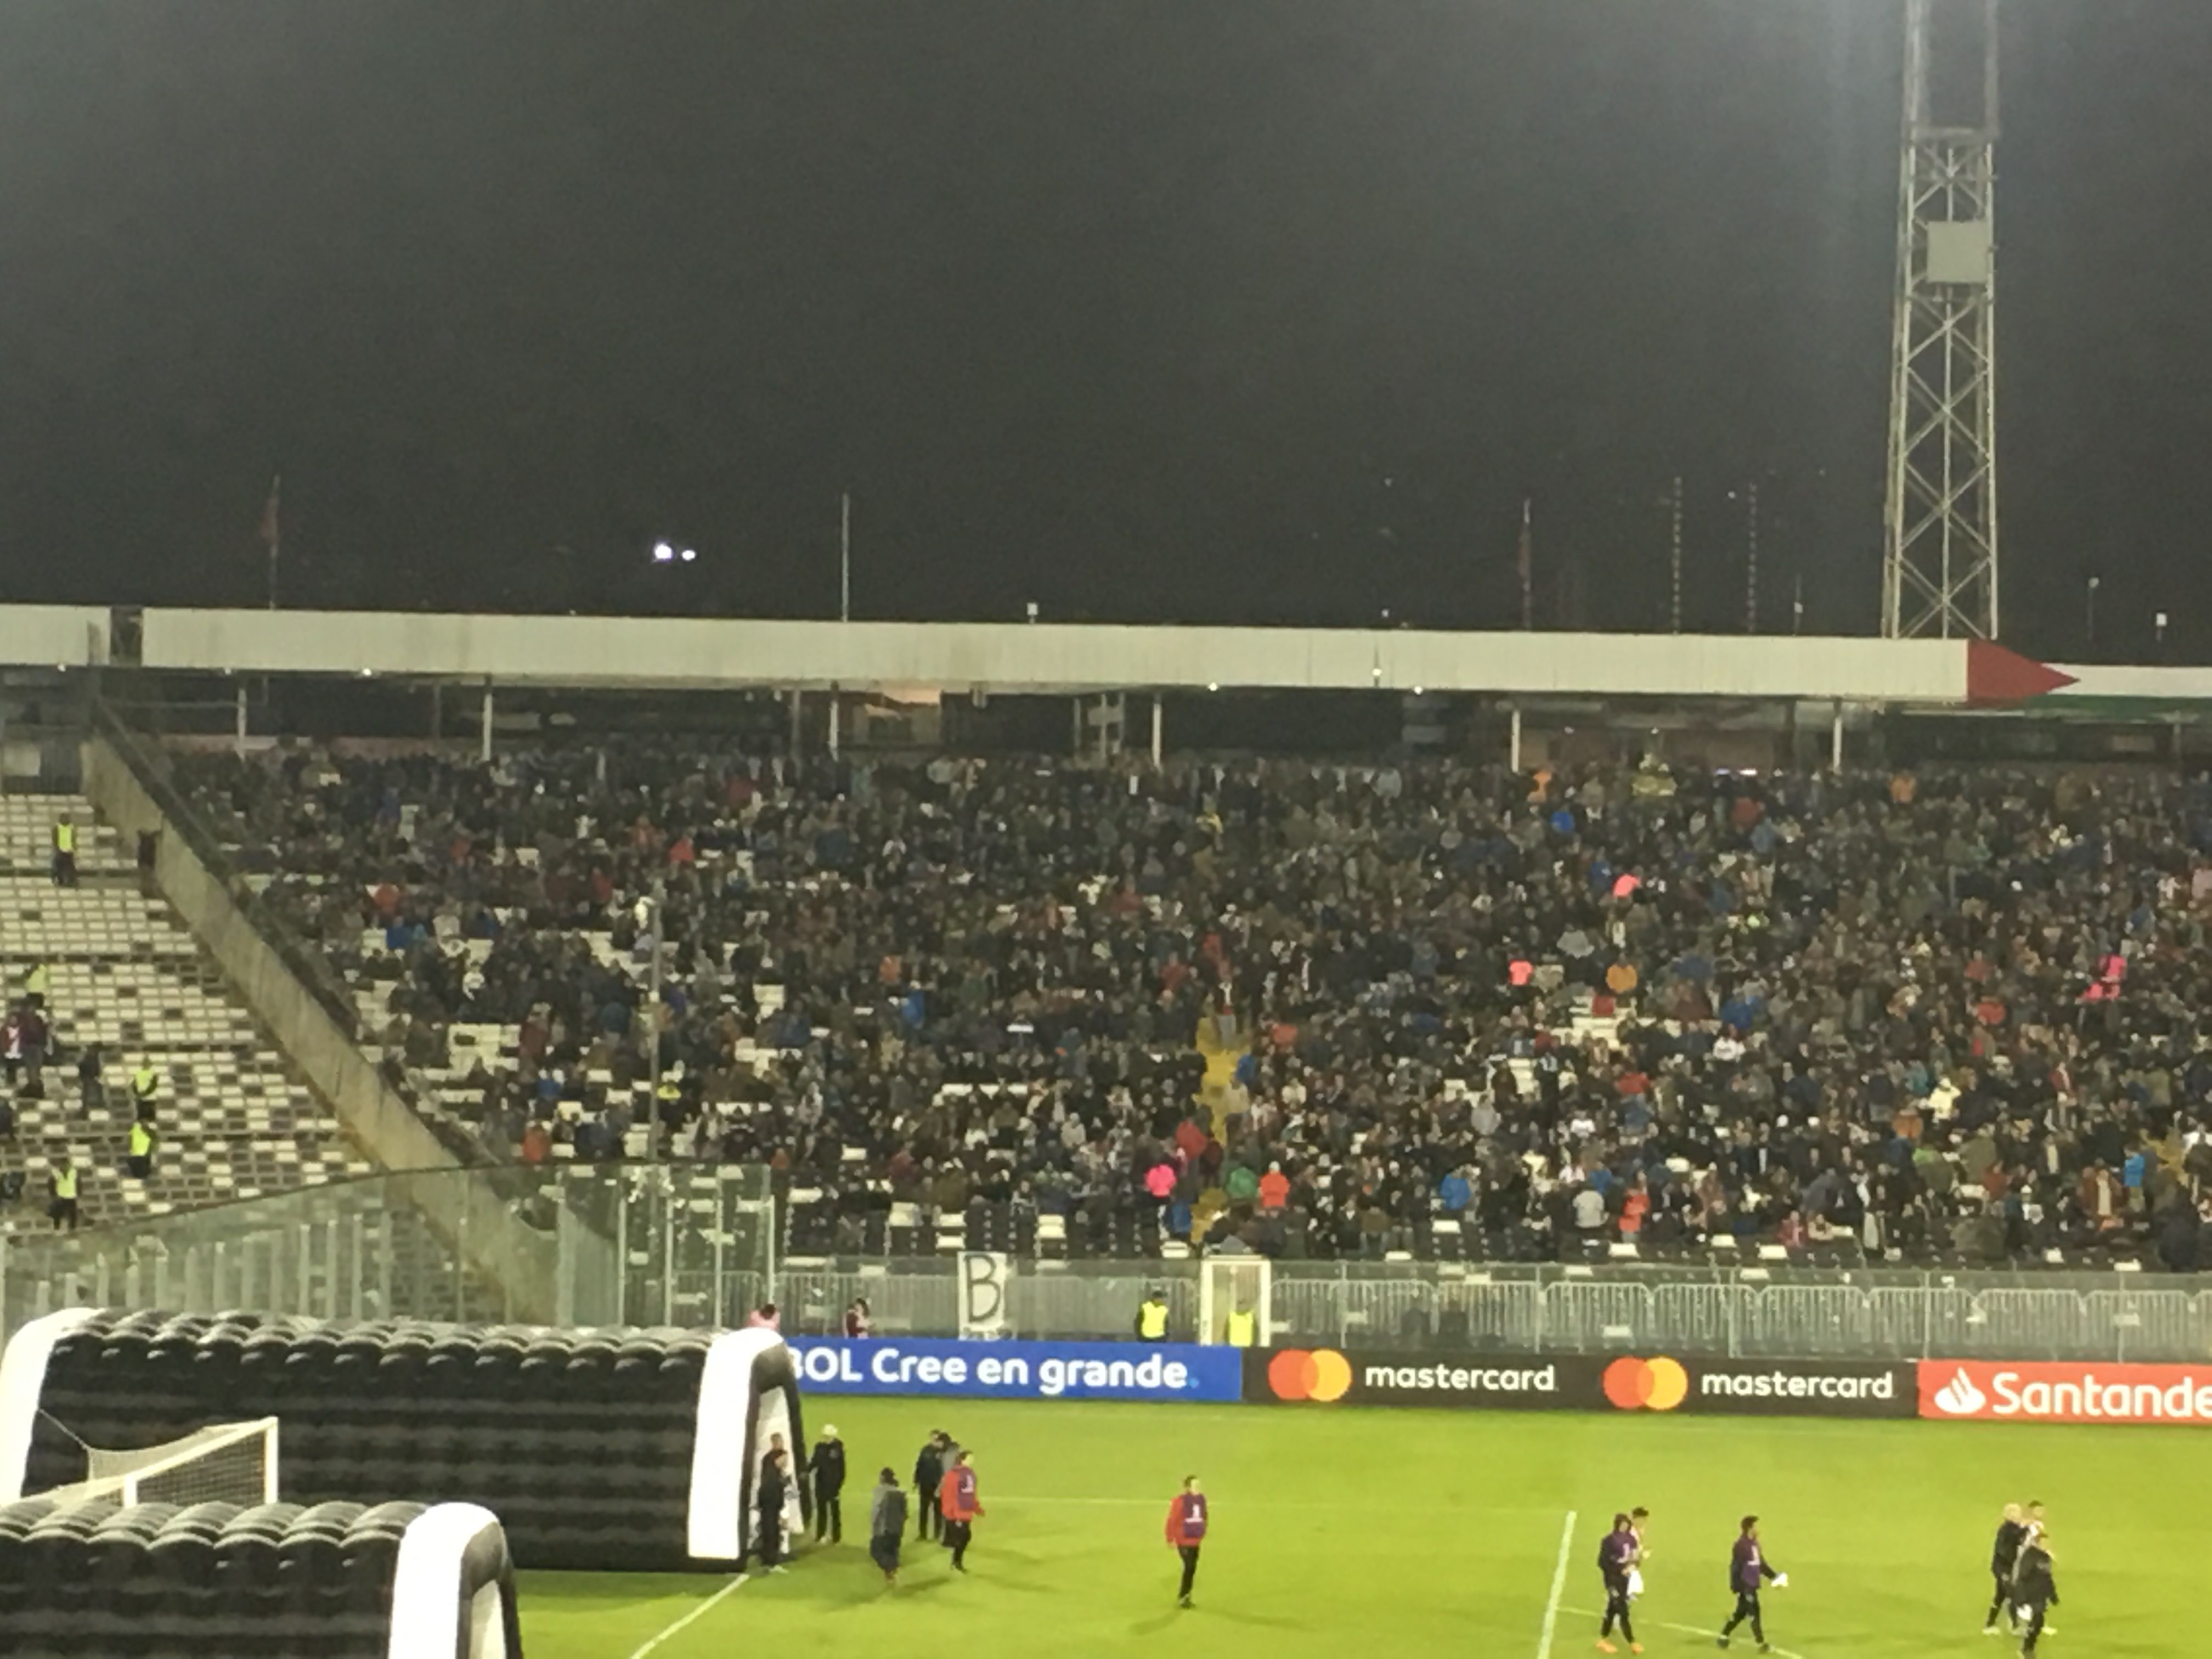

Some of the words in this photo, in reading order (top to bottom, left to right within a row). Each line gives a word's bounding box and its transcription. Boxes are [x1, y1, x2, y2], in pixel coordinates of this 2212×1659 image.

[964, 1254, 1001, 1323] B
[871, 1347, 967, 1383] Cree
[977, 1358, 1028, 1384] en
[1365, 1364, 1555, 1391] mastercard
[1701, 1371, 1893, 1398] mastercard
